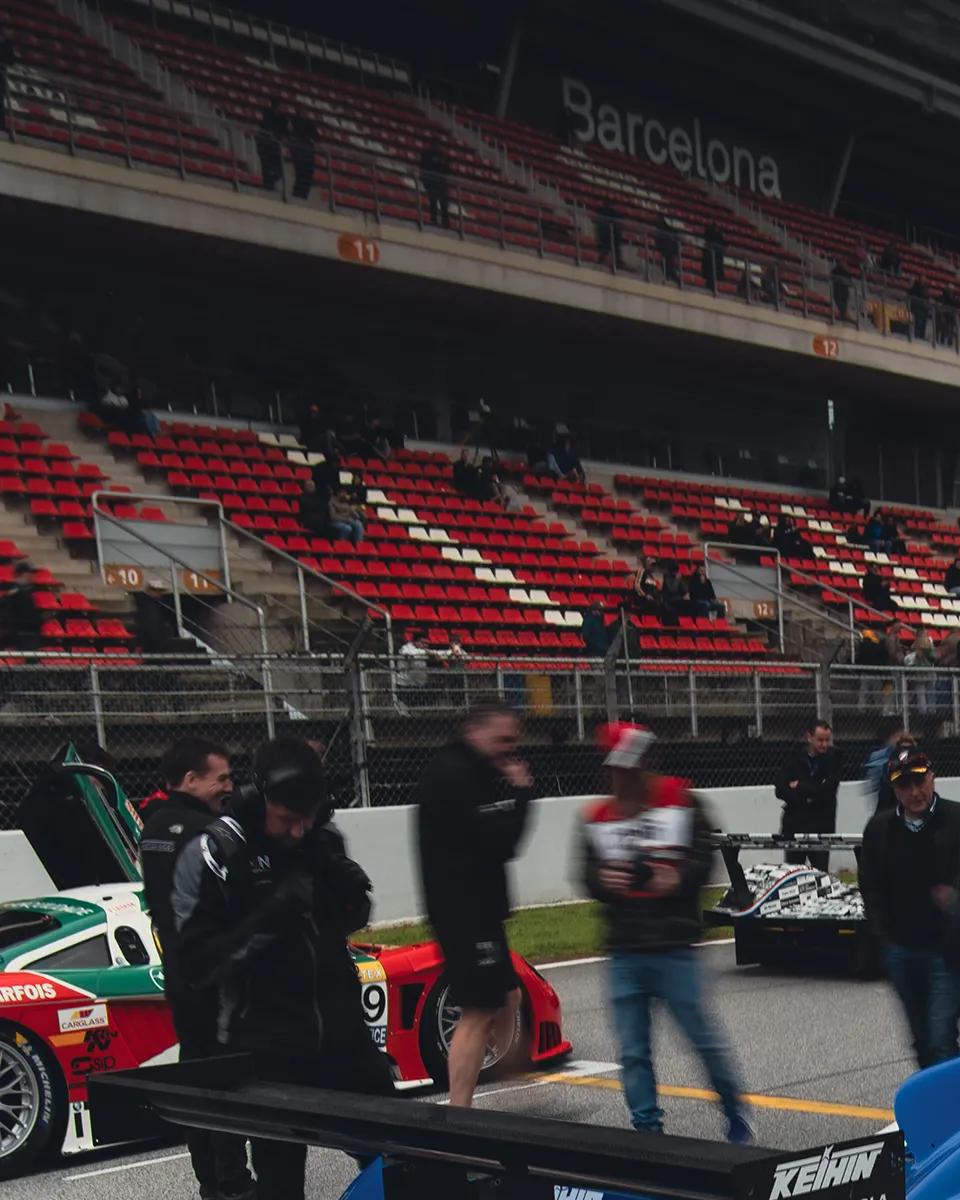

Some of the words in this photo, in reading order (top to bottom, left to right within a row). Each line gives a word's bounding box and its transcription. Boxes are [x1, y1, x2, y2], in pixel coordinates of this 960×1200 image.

[562, 77, 781, 199] Barcelona
[353, 239, 374, 262] 11
[822, 339, 838, 358] 12
[118, 569, 139, 585] 10
[60, 1018, 106, 1030] CARGLASS
